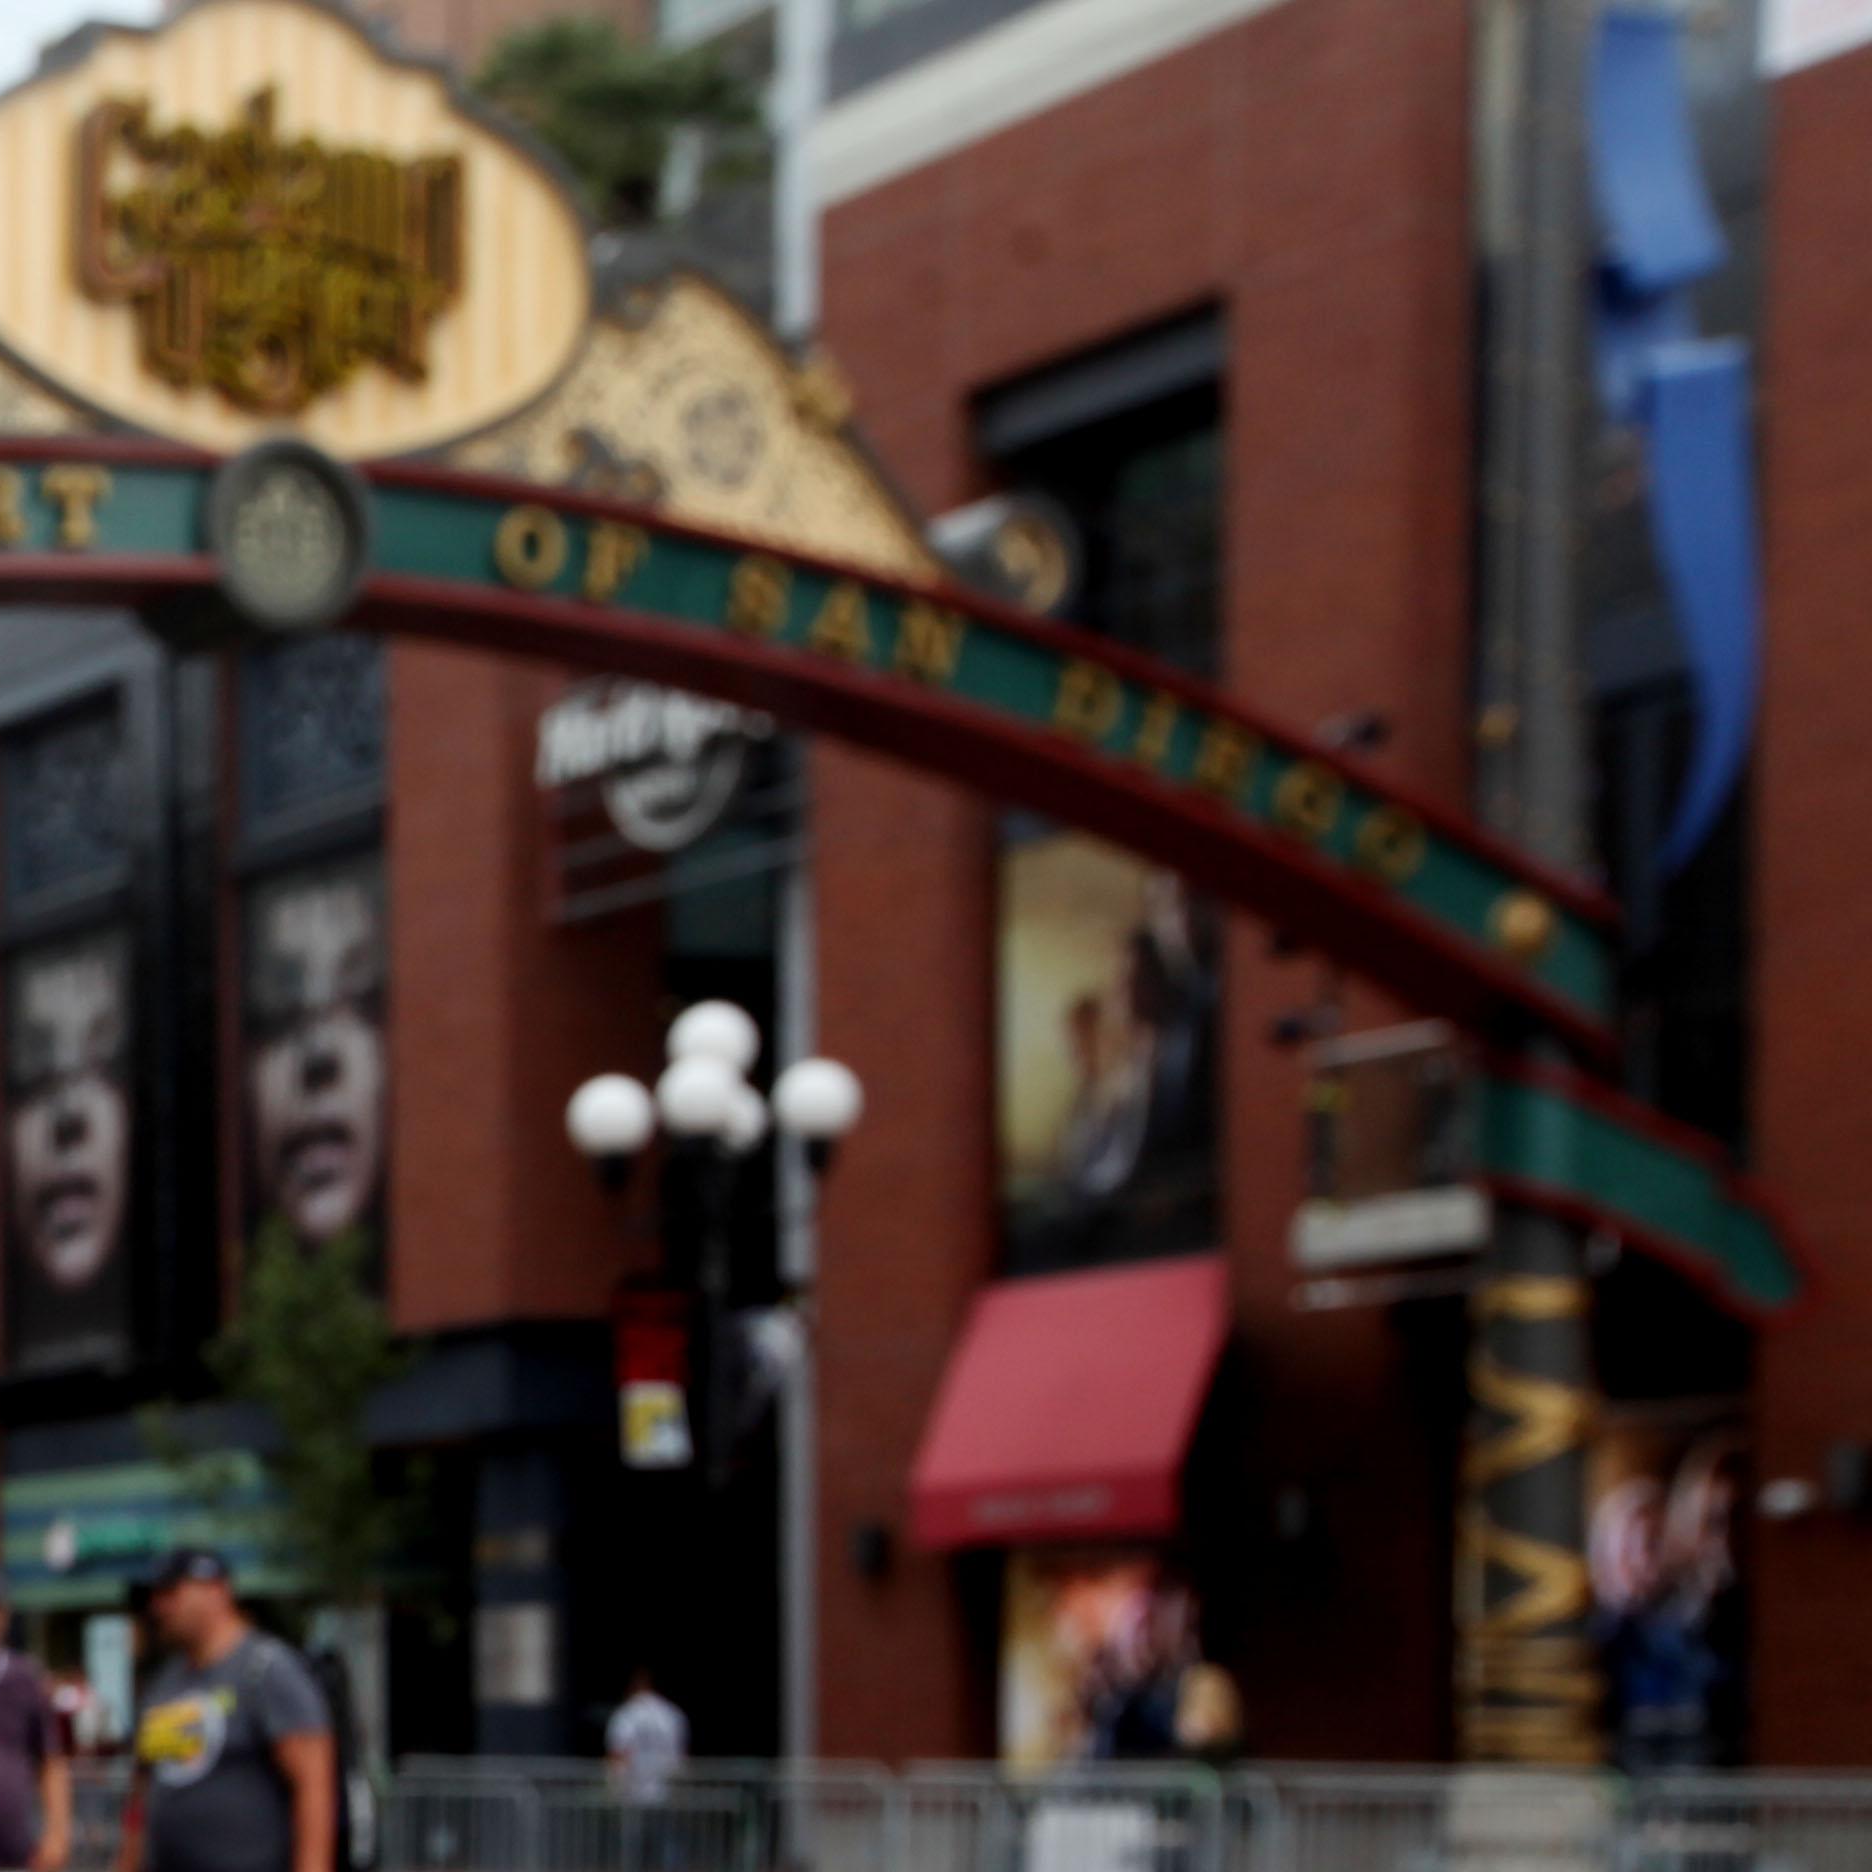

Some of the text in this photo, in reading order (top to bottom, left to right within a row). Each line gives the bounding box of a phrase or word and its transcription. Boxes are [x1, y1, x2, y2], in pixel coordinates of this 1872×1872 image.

[495, 504, 650, 603] OF
[731, 554, 965, 685] SAN
[1053, 662, 1429, 883] DIEGO
